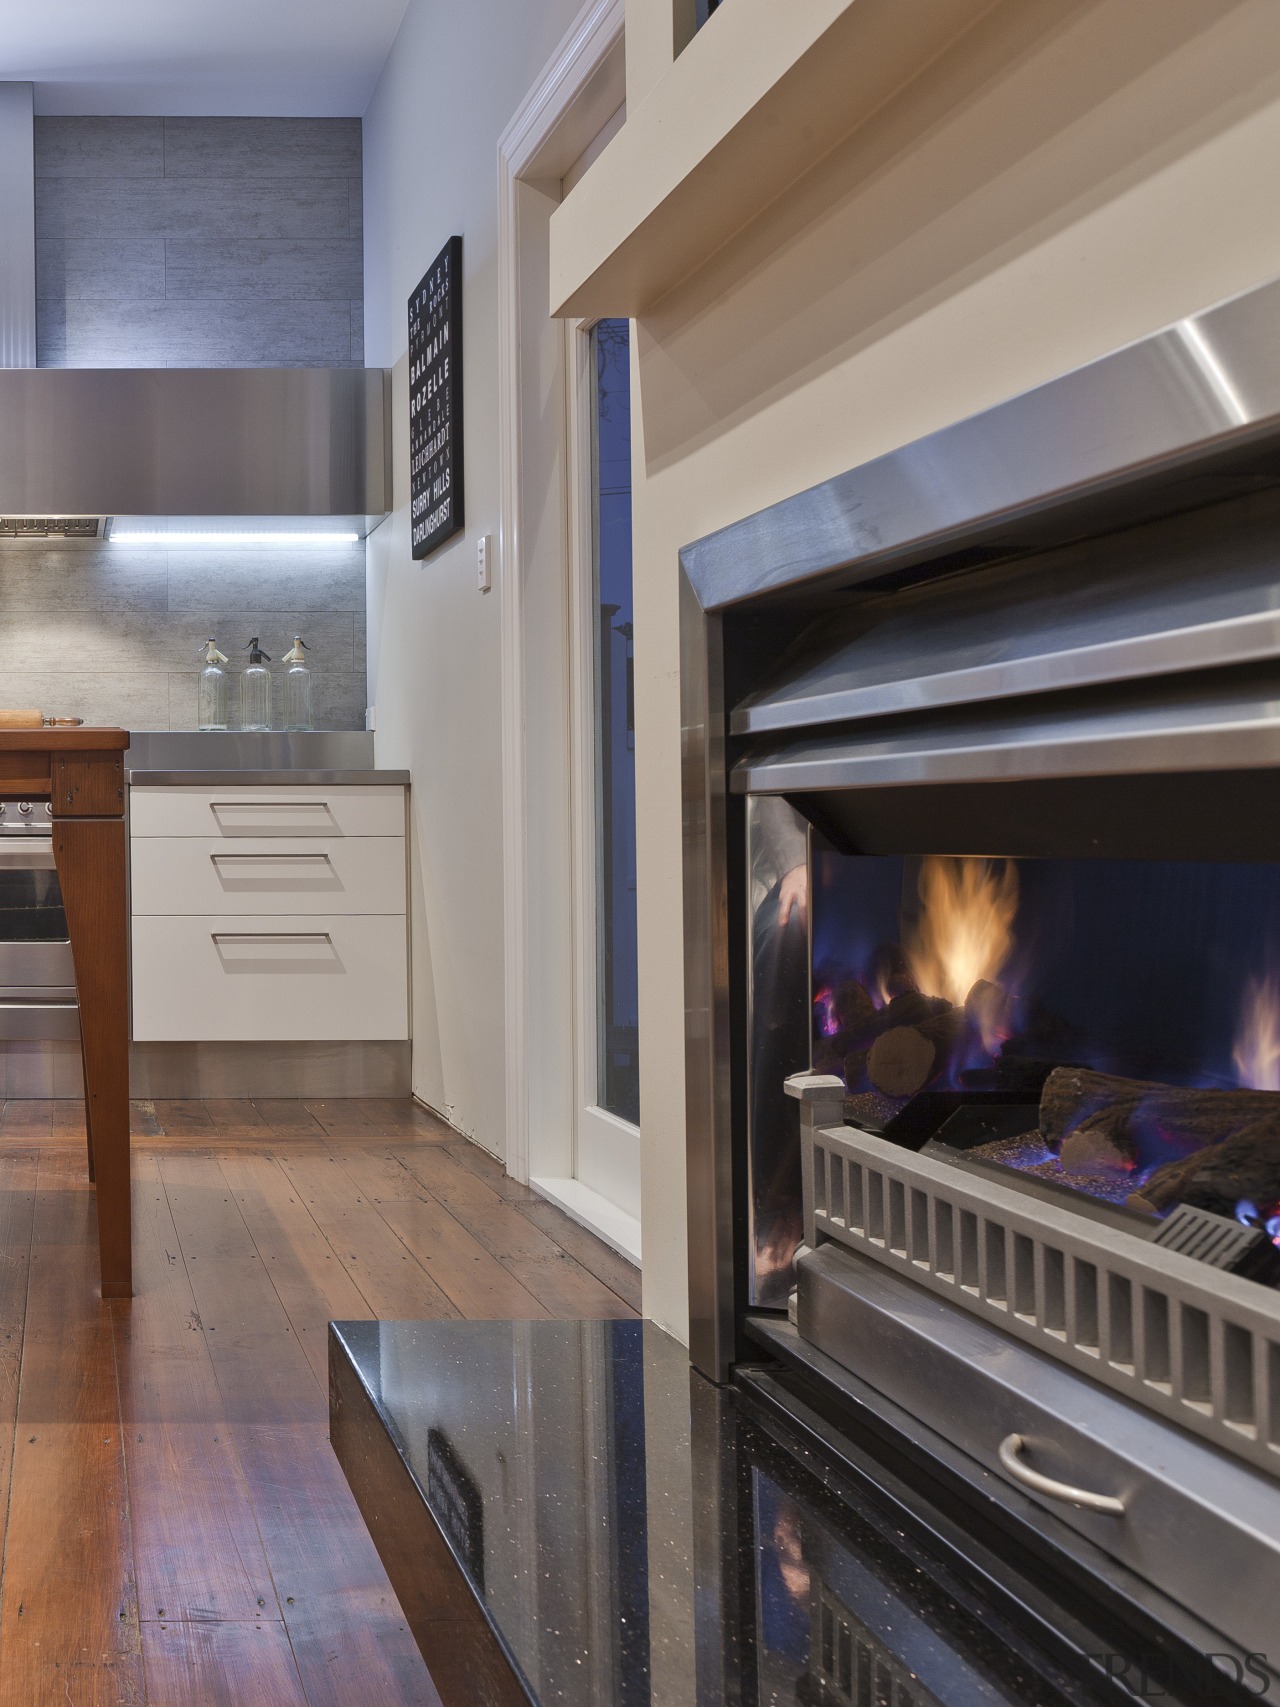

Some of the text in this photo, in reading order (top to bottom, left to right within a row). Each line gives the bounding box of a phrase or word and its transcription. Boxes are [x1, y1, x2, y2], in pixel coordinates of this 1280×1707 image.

[409, 255, 449, 322] SYDNEY
[410, 277, 449, 340] THE ROCKS
[410, 296, 449, 358] PYRMONT
[410, 320, 449, 386] BALMAIN
[411, 356, 449, 419] ROZELLE
[411, 386, 449, 439] GLEBE
[411, 403, 450, 454] ANNANDALE
[412, 421, 450, 476] LEICHHARDT
[412, 446, 450, 494] NEWTOWN
[412, 467, 450, 519] SURRY HILLS
[413, 496, 451, 547] DARLINGHURST
